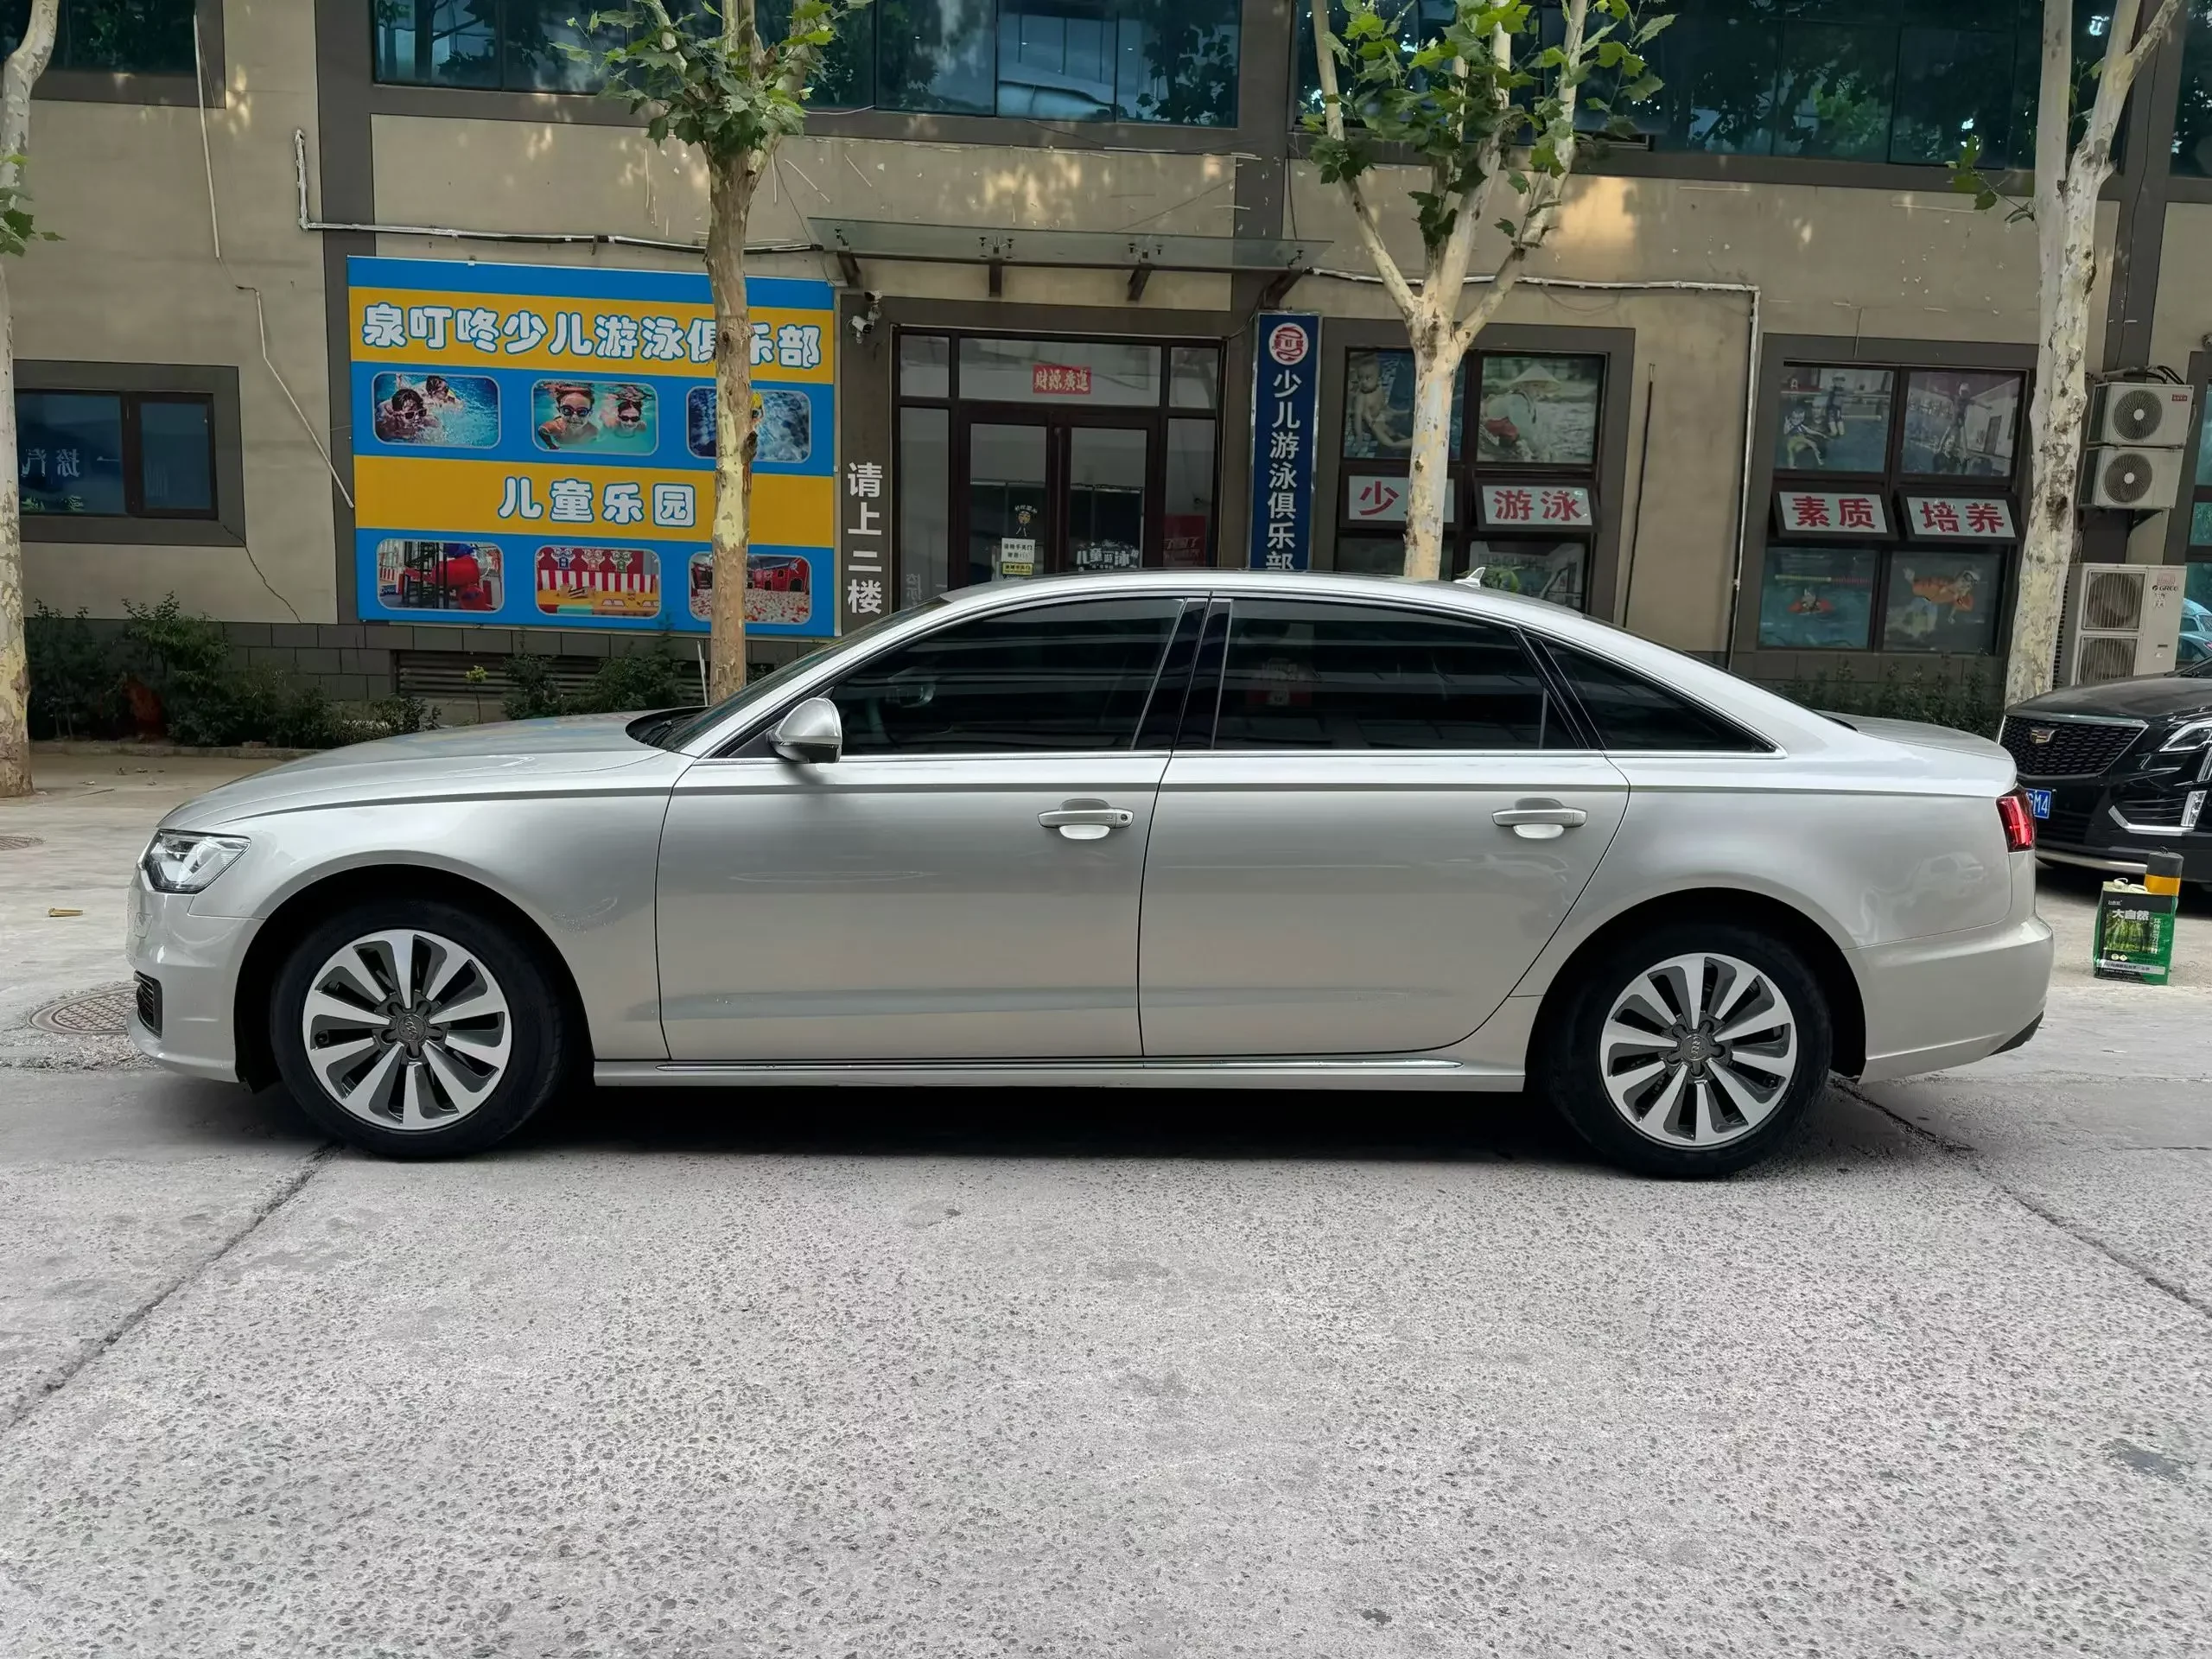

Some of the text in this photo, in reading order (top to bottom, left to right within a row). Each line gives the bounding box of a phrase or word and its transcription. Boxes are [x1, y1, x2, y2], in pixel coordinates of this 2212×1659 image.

[498, 475, 696, 528] 儿童乐园
[1358, 480, 1583, 522] 少 游泳
[1791, 495, 2005, 534] 素质 培养
[848, 462, 883, 615] 请上二楼
[2112, 909, 2150, 921] 大自然
